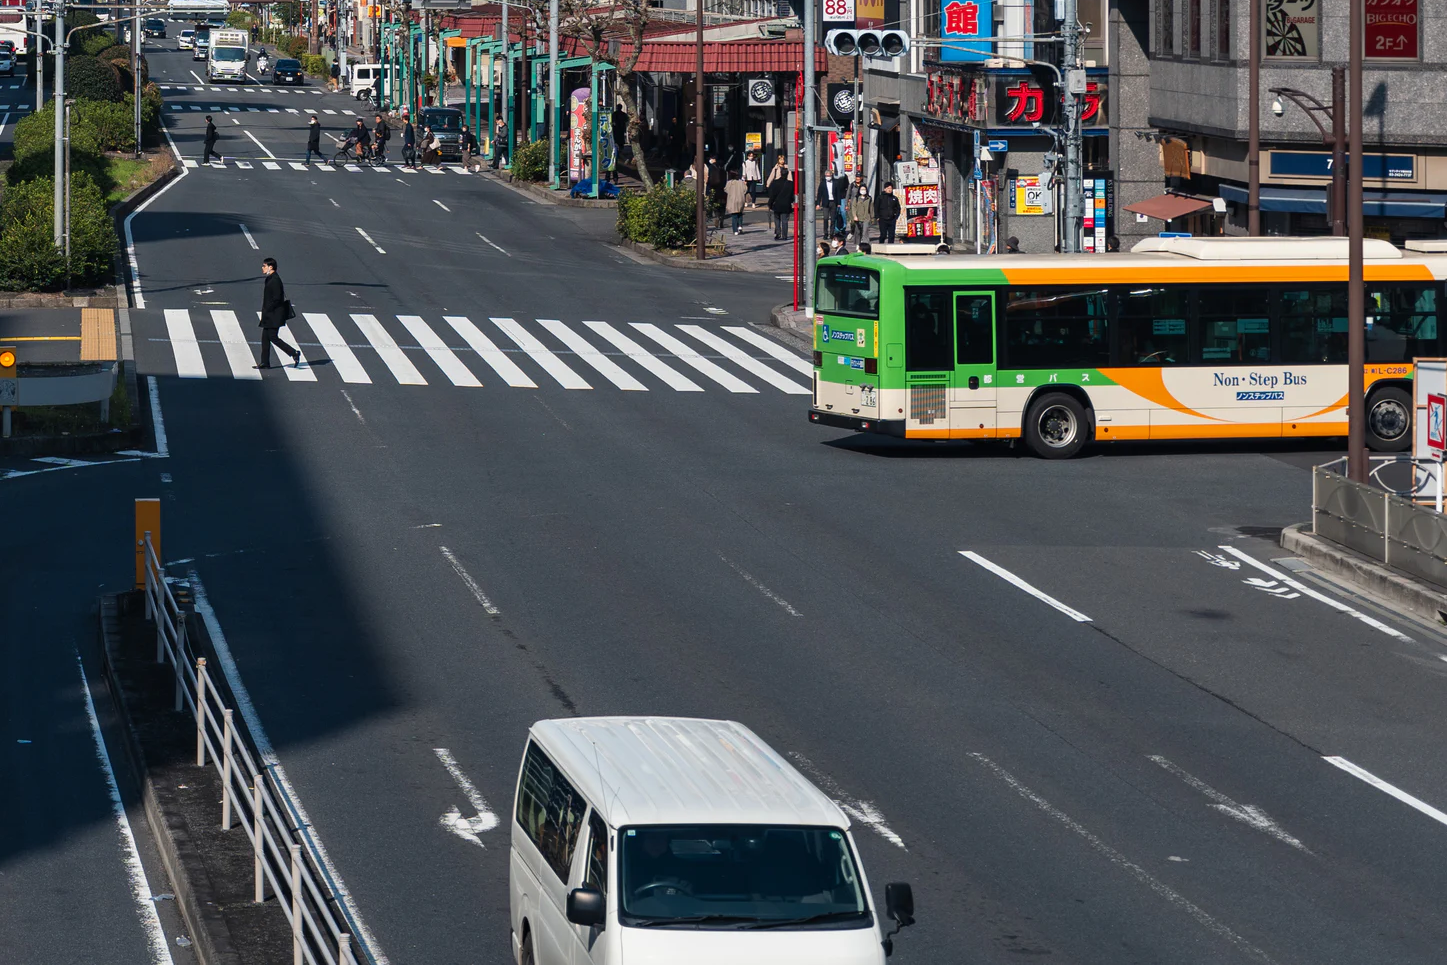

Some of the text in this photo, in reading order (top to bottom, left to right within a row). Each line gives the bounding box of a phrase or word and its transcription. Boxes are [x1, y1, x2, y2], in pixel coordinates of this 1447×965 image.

[1366, 12, 1417, 24] BIG ECHO
[1375, 36, 1393, 50] 2F
[908, 189, 938, 205] 焼肉
[1378, 367, 1408, 375] L-C286
[983, 373, 1090, 384] 都営バス
[1283, 371, 1308, 385] Bus
[1236, 391, 1285, 400] ノンステップバス
